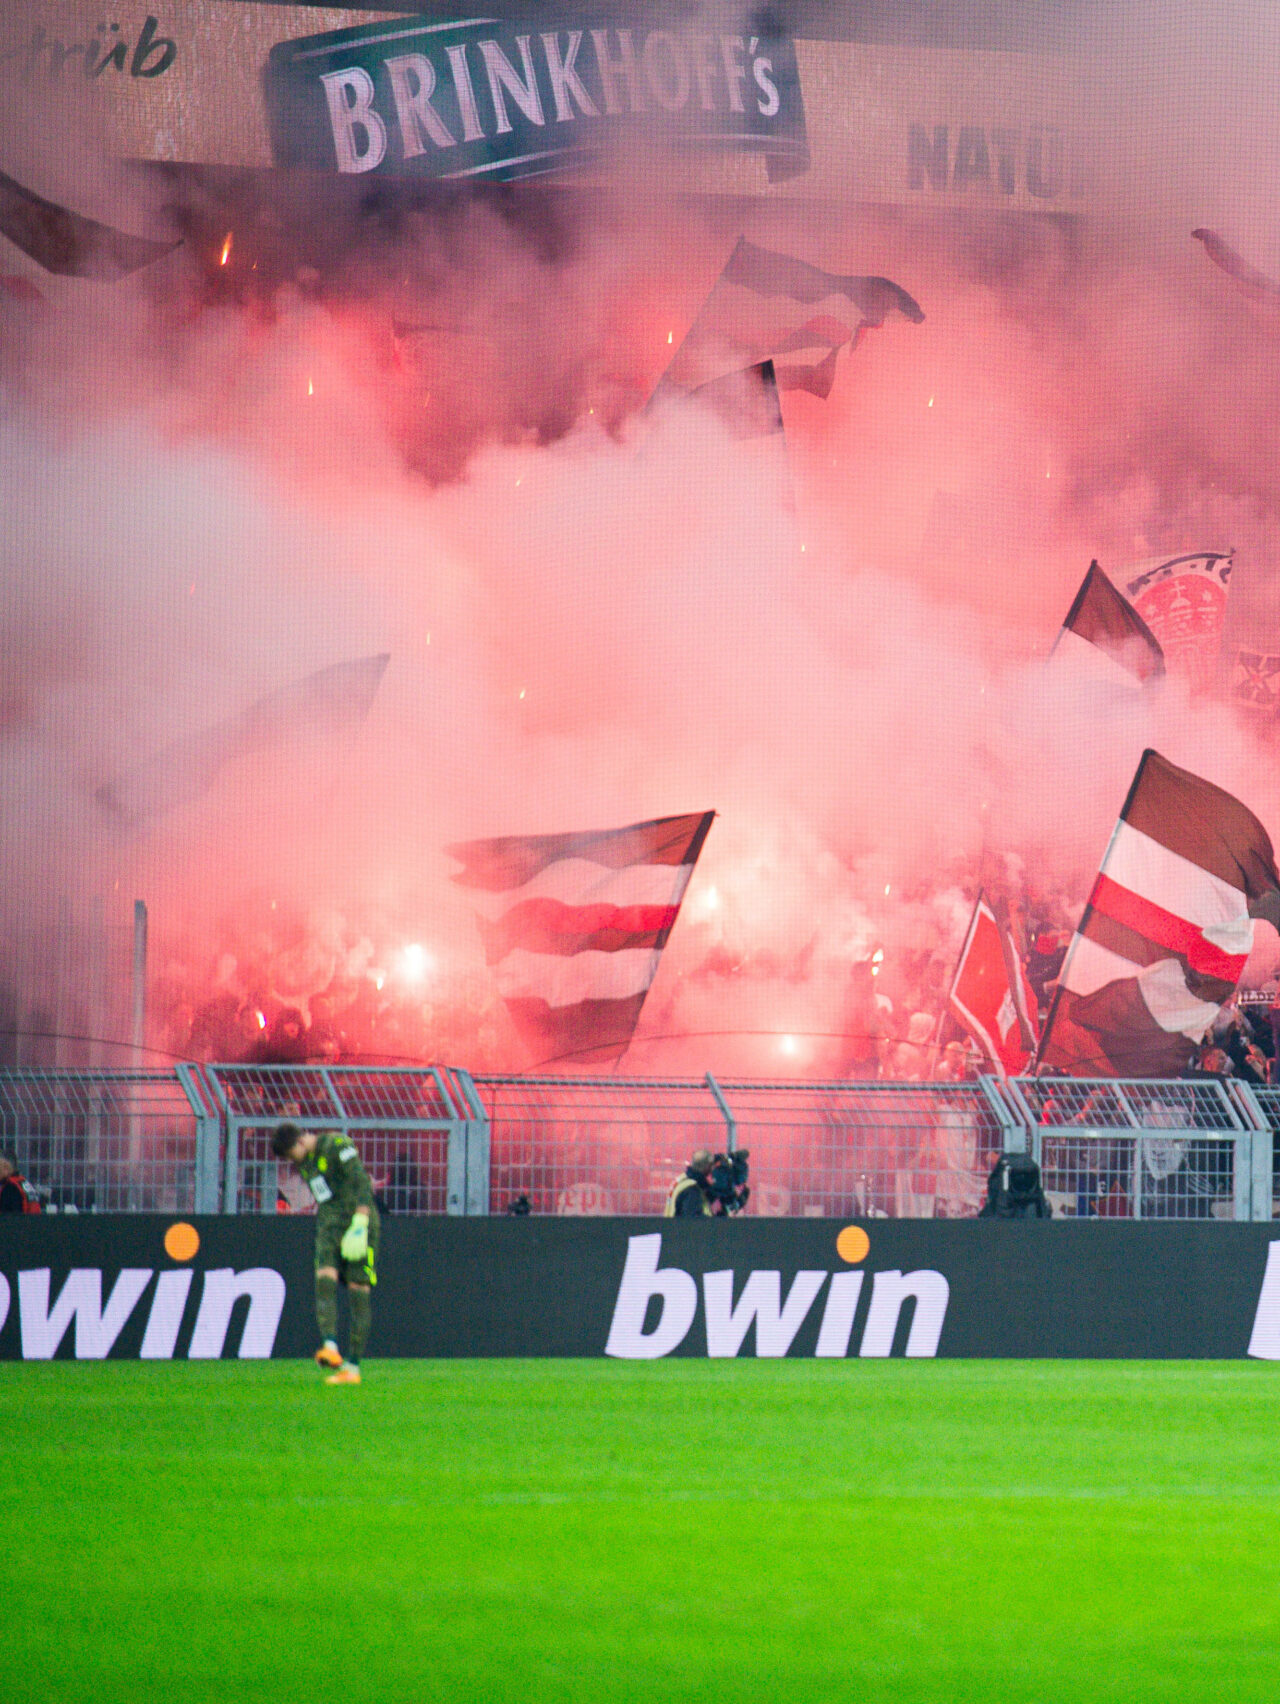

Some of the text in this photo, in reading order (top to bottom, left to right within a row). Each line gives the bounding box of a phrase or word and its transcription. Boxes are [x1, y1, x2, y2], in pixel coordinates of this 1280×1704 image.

[906, 123, 1084, 198] NATU
[0, 1221, 286, 1360] win
[604, 1225, 949, 1360] bwin
